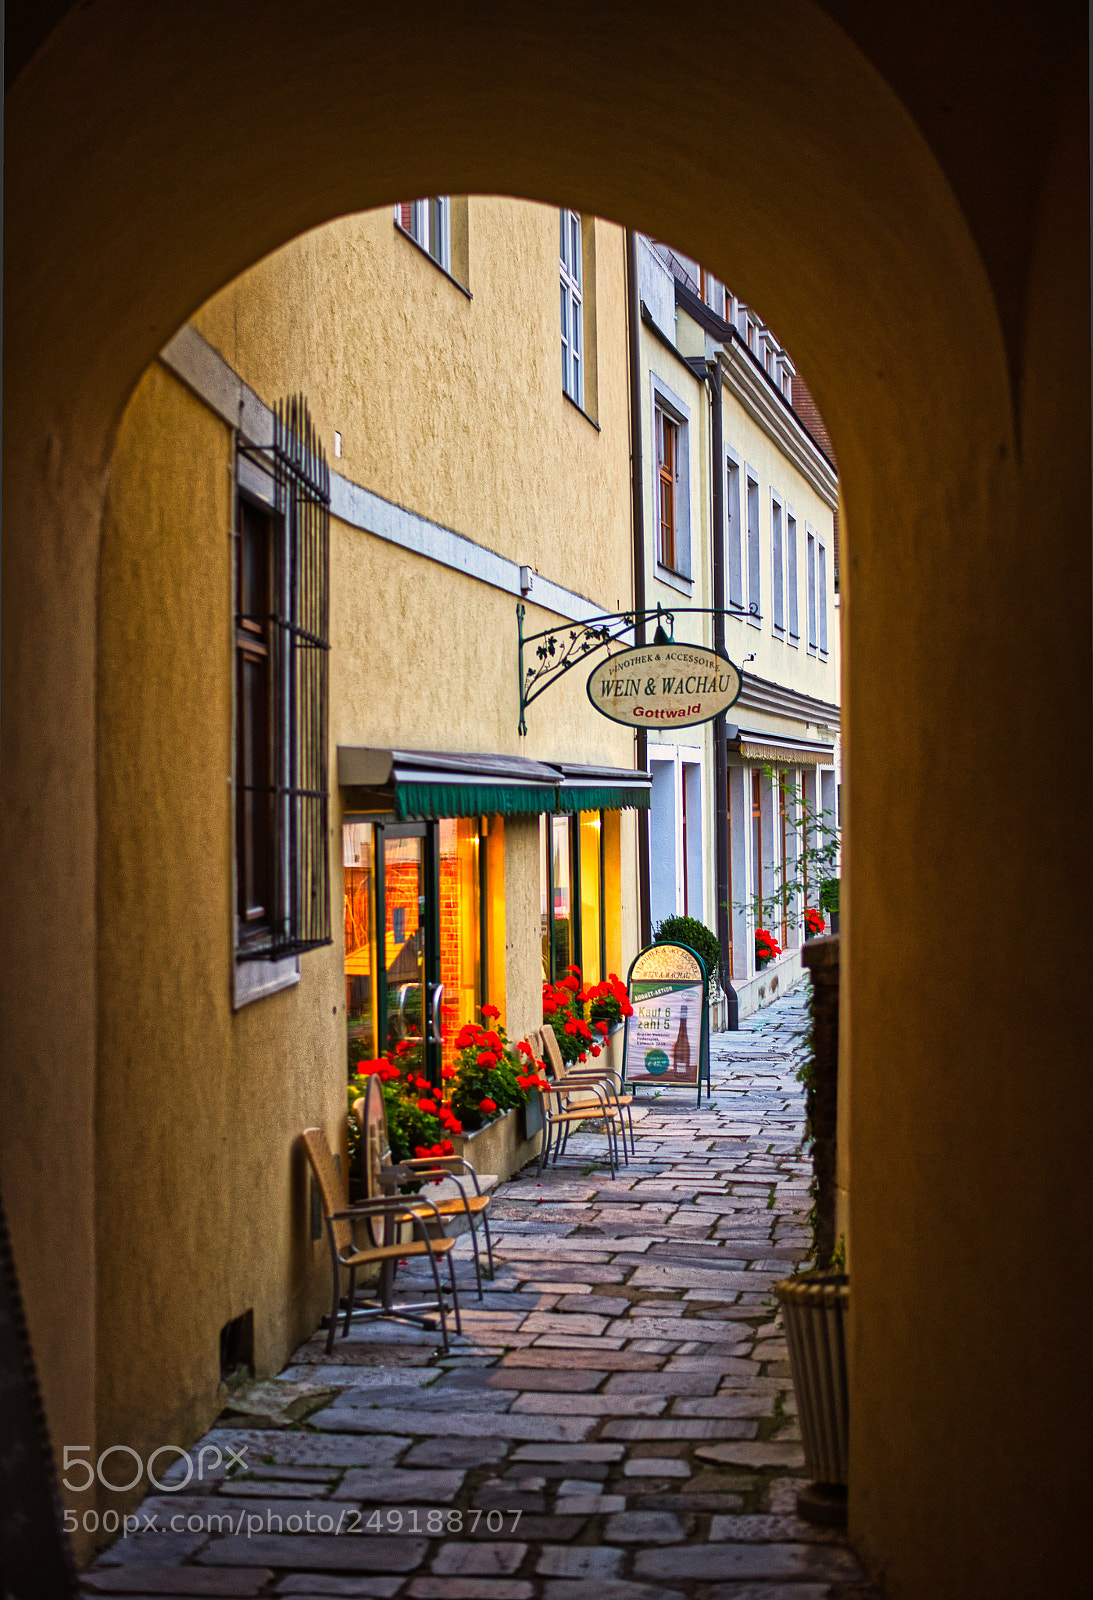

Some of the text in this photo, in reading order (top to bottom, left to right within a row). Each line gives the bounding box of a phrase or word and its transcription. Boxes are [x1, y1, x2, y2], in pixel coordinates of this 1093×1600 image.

[655, 653, 661, 661] &
[665, 653, 721, 672] ACCESSOIRE
[601, 675, 731, 698] WEIN & WACHAU
[633, 703, 702, 719] Gottwald
[638, 1007, 671, 1018] Kauf 6
[637, 1019, 670, 1029] zahl 5
